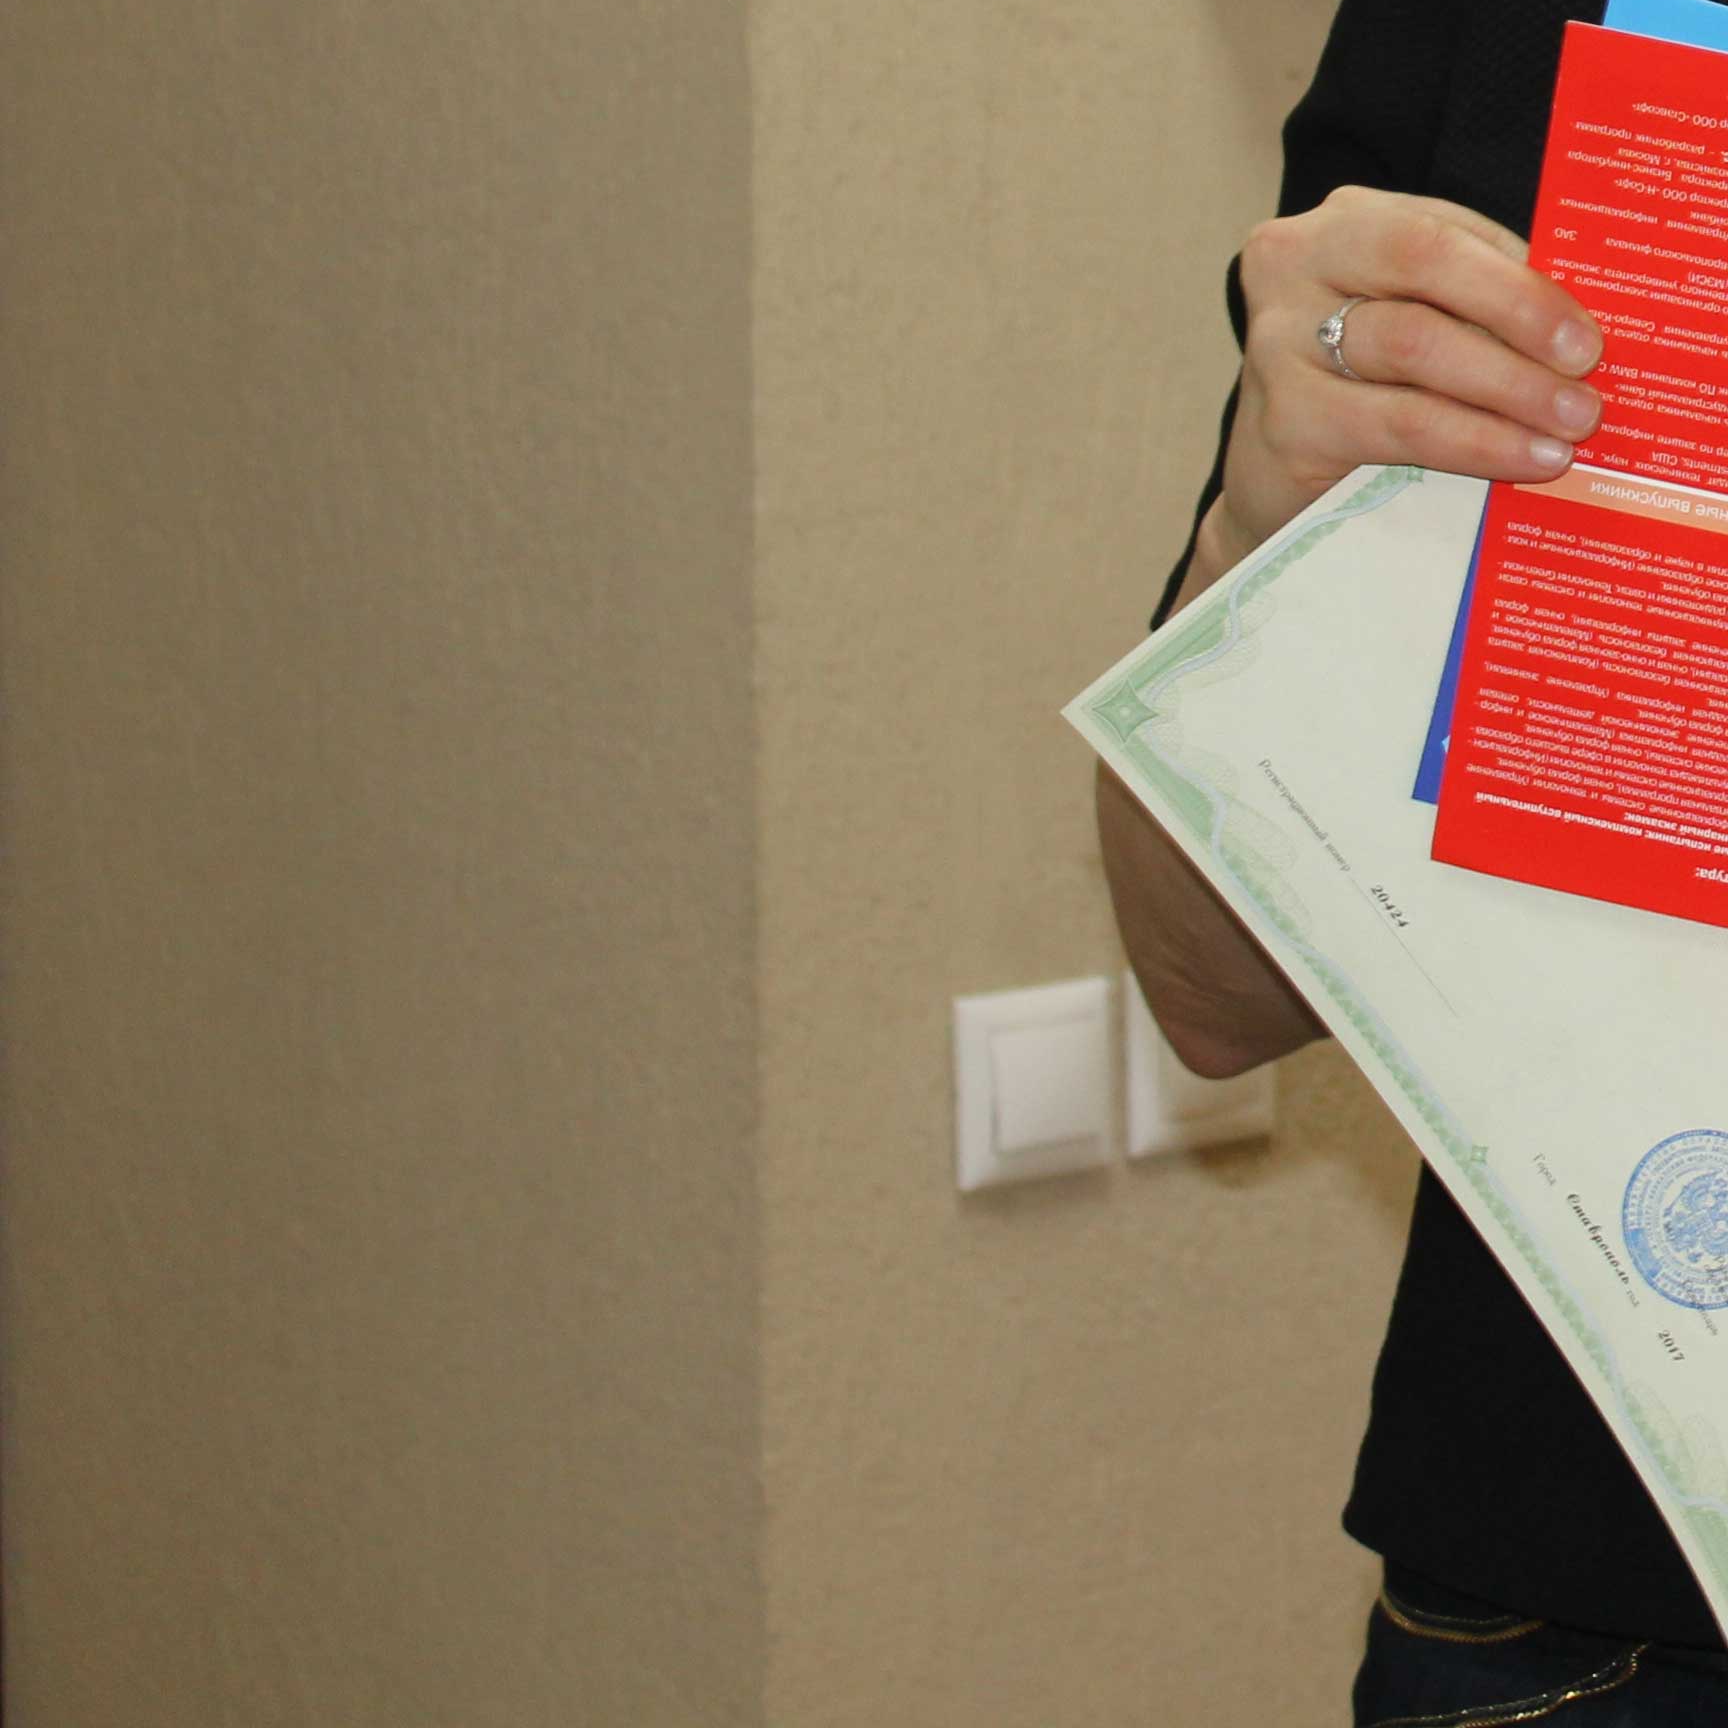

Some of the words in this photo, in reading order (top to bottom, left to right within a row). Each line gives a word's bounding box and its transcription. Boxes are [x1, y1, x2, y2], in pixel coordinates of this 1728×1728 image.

[1589, 476, 1692, 514] выпускники
[1473, 791, 1563, 819] вступительный
[1561, 810, 1643, 837] комплексный
[1623, 811, 1678, 831] экзамен:
[1643, 829, 1712, 852] испытания:
[1370, 887, 1409, 928] 20424
[1657, 1332, 1685, 1361] 2017
